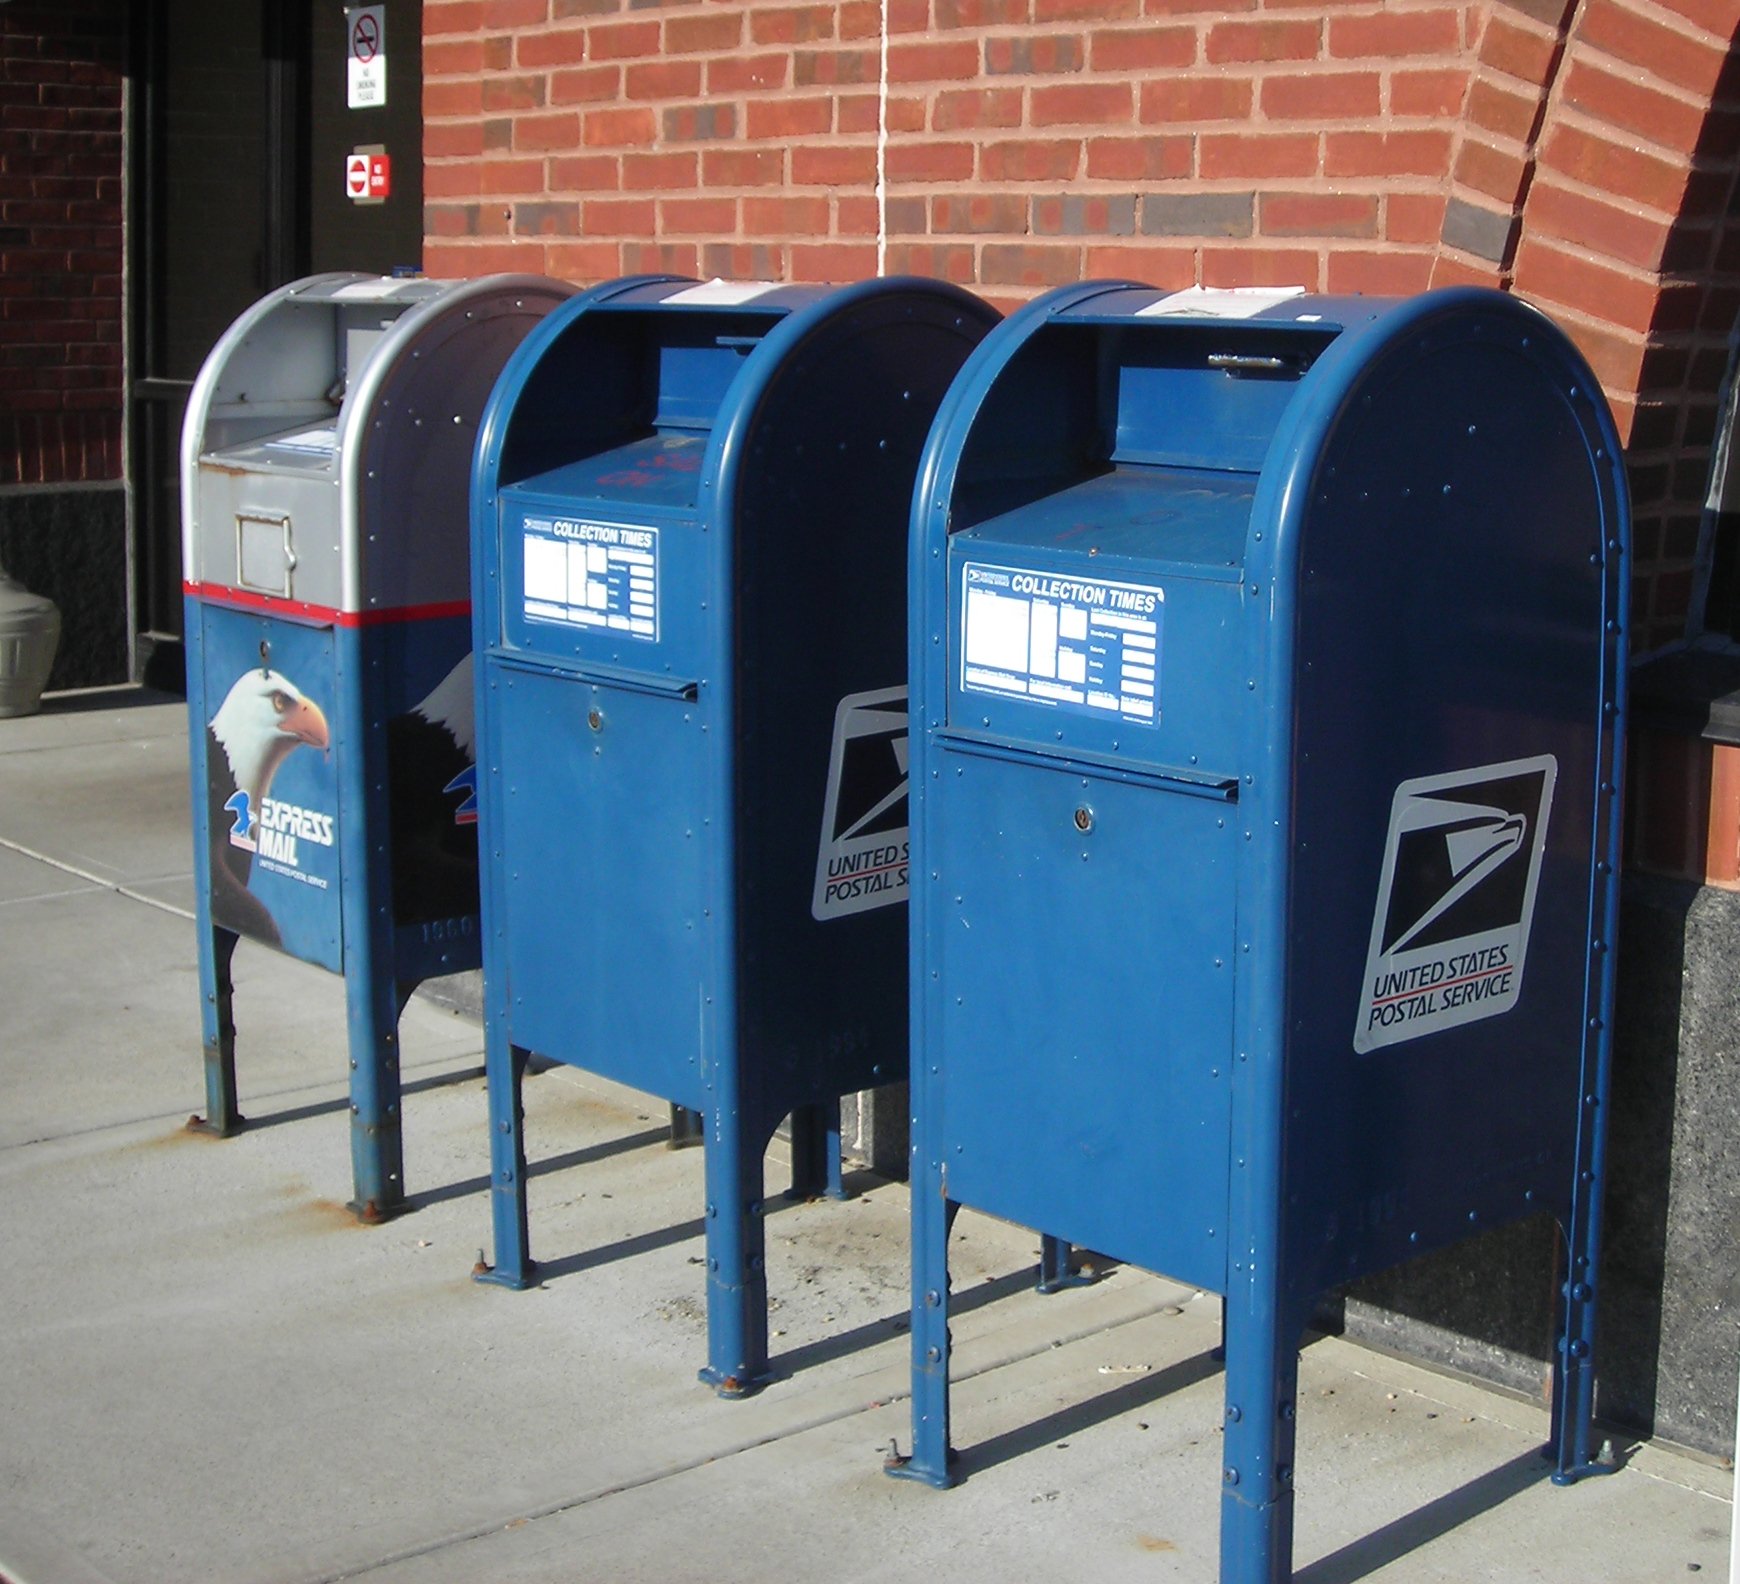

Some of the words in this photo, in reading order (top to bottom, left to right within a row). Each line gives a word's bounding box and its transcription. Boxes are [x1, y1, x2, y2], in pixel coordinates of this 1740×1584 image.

[553, 521, 618, 544] COLLECTION
[620, 530, 653, 548] TIMES
[1011, 574, 1106, 605] COLLECTION
[1110, 589, 1156, 613] TIMES
[260, 797, 333, 846] EXPRESS
[258, 827, 298, 866] MAIL
[828, 845, 898, 877] UNITED
[824, 871, 894, 905] POSTAL
[1373, 960, 1446, 999] UNITED
[1446, 943, 1509, 980] STATES
[1367, 993, 1438, 1032] POSTAL
[1440, 971, 1513, 1012] SERVICE
